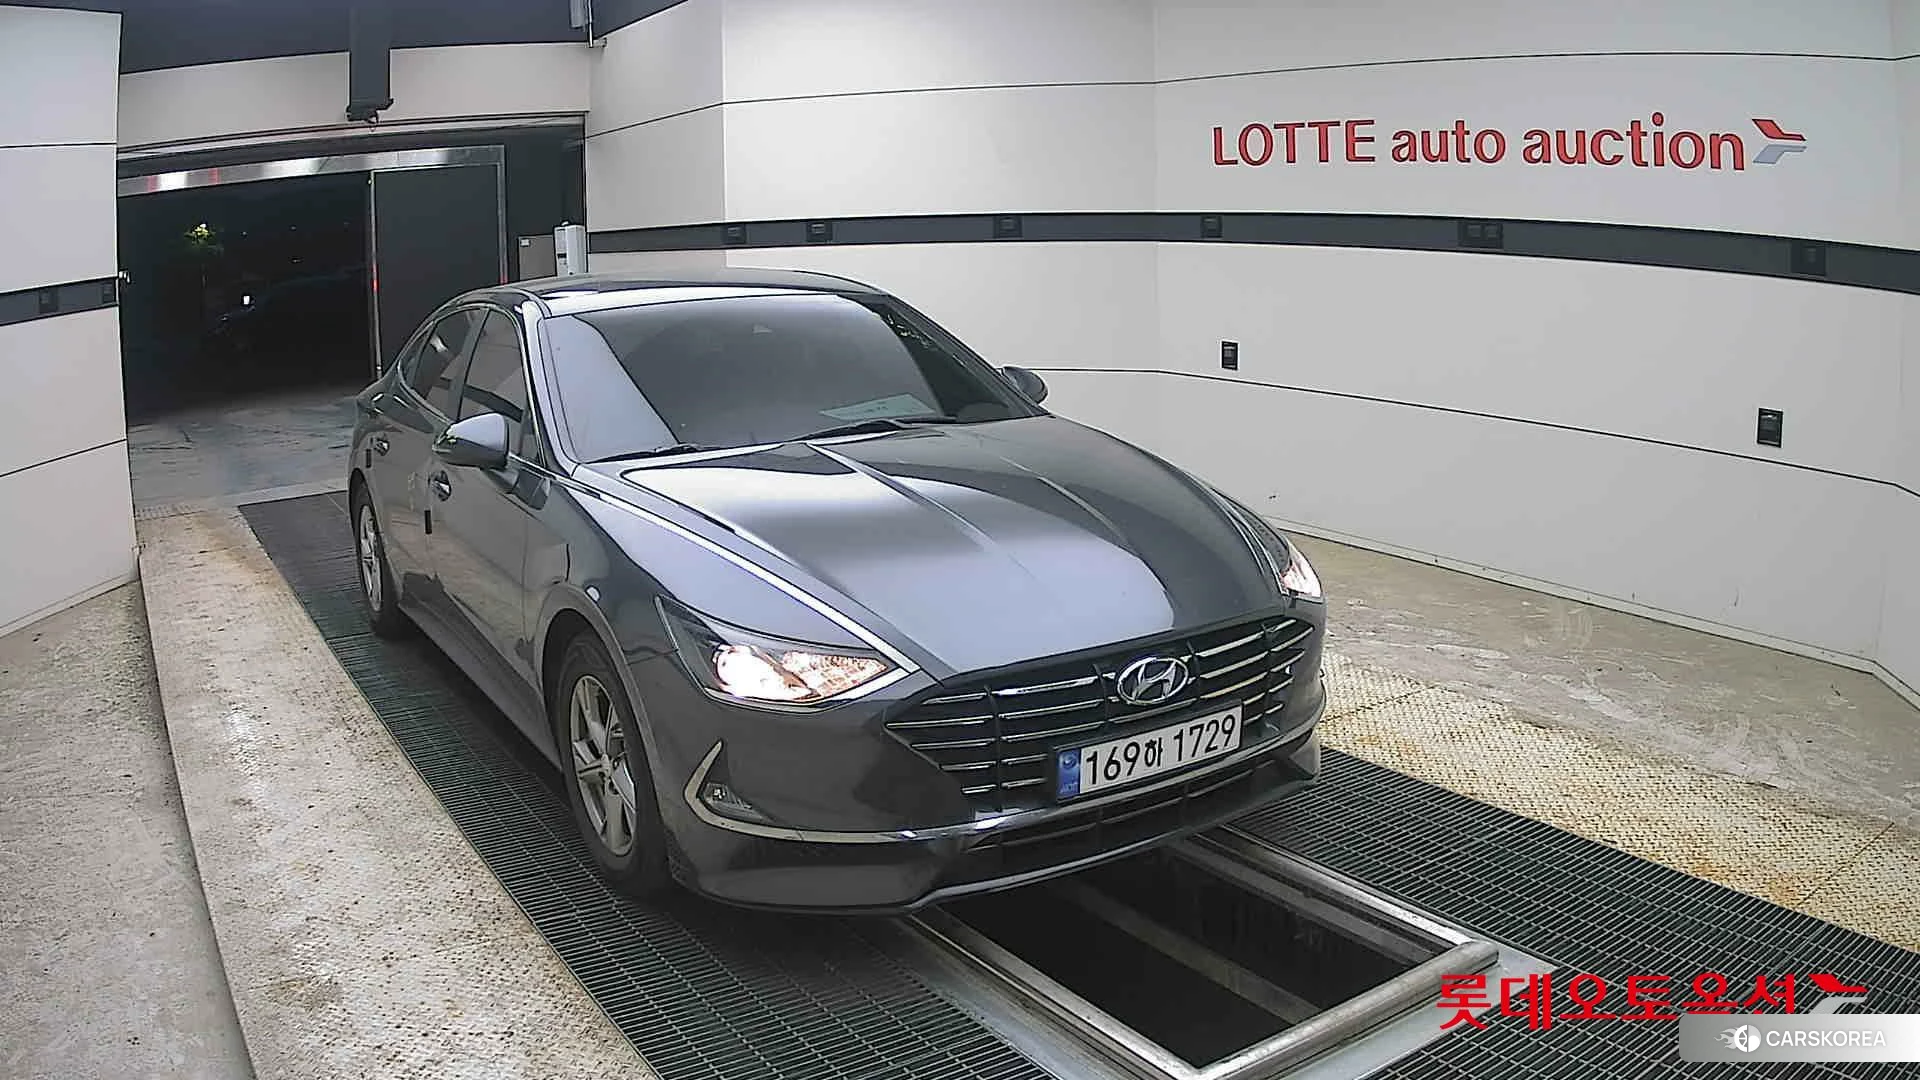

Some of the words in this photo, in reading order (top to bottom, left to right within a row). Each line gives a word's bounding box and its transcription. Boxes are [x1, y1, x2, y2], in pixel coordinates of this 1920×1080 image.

[1213, 119, 1376, 166] LOTTE
[1391, 119, 1507, 163] auto
[1521, 111, 1746, 170] auction
[1085, 741, 1163, 785] 169하
[1173, 714, 1237, 762] 1729
